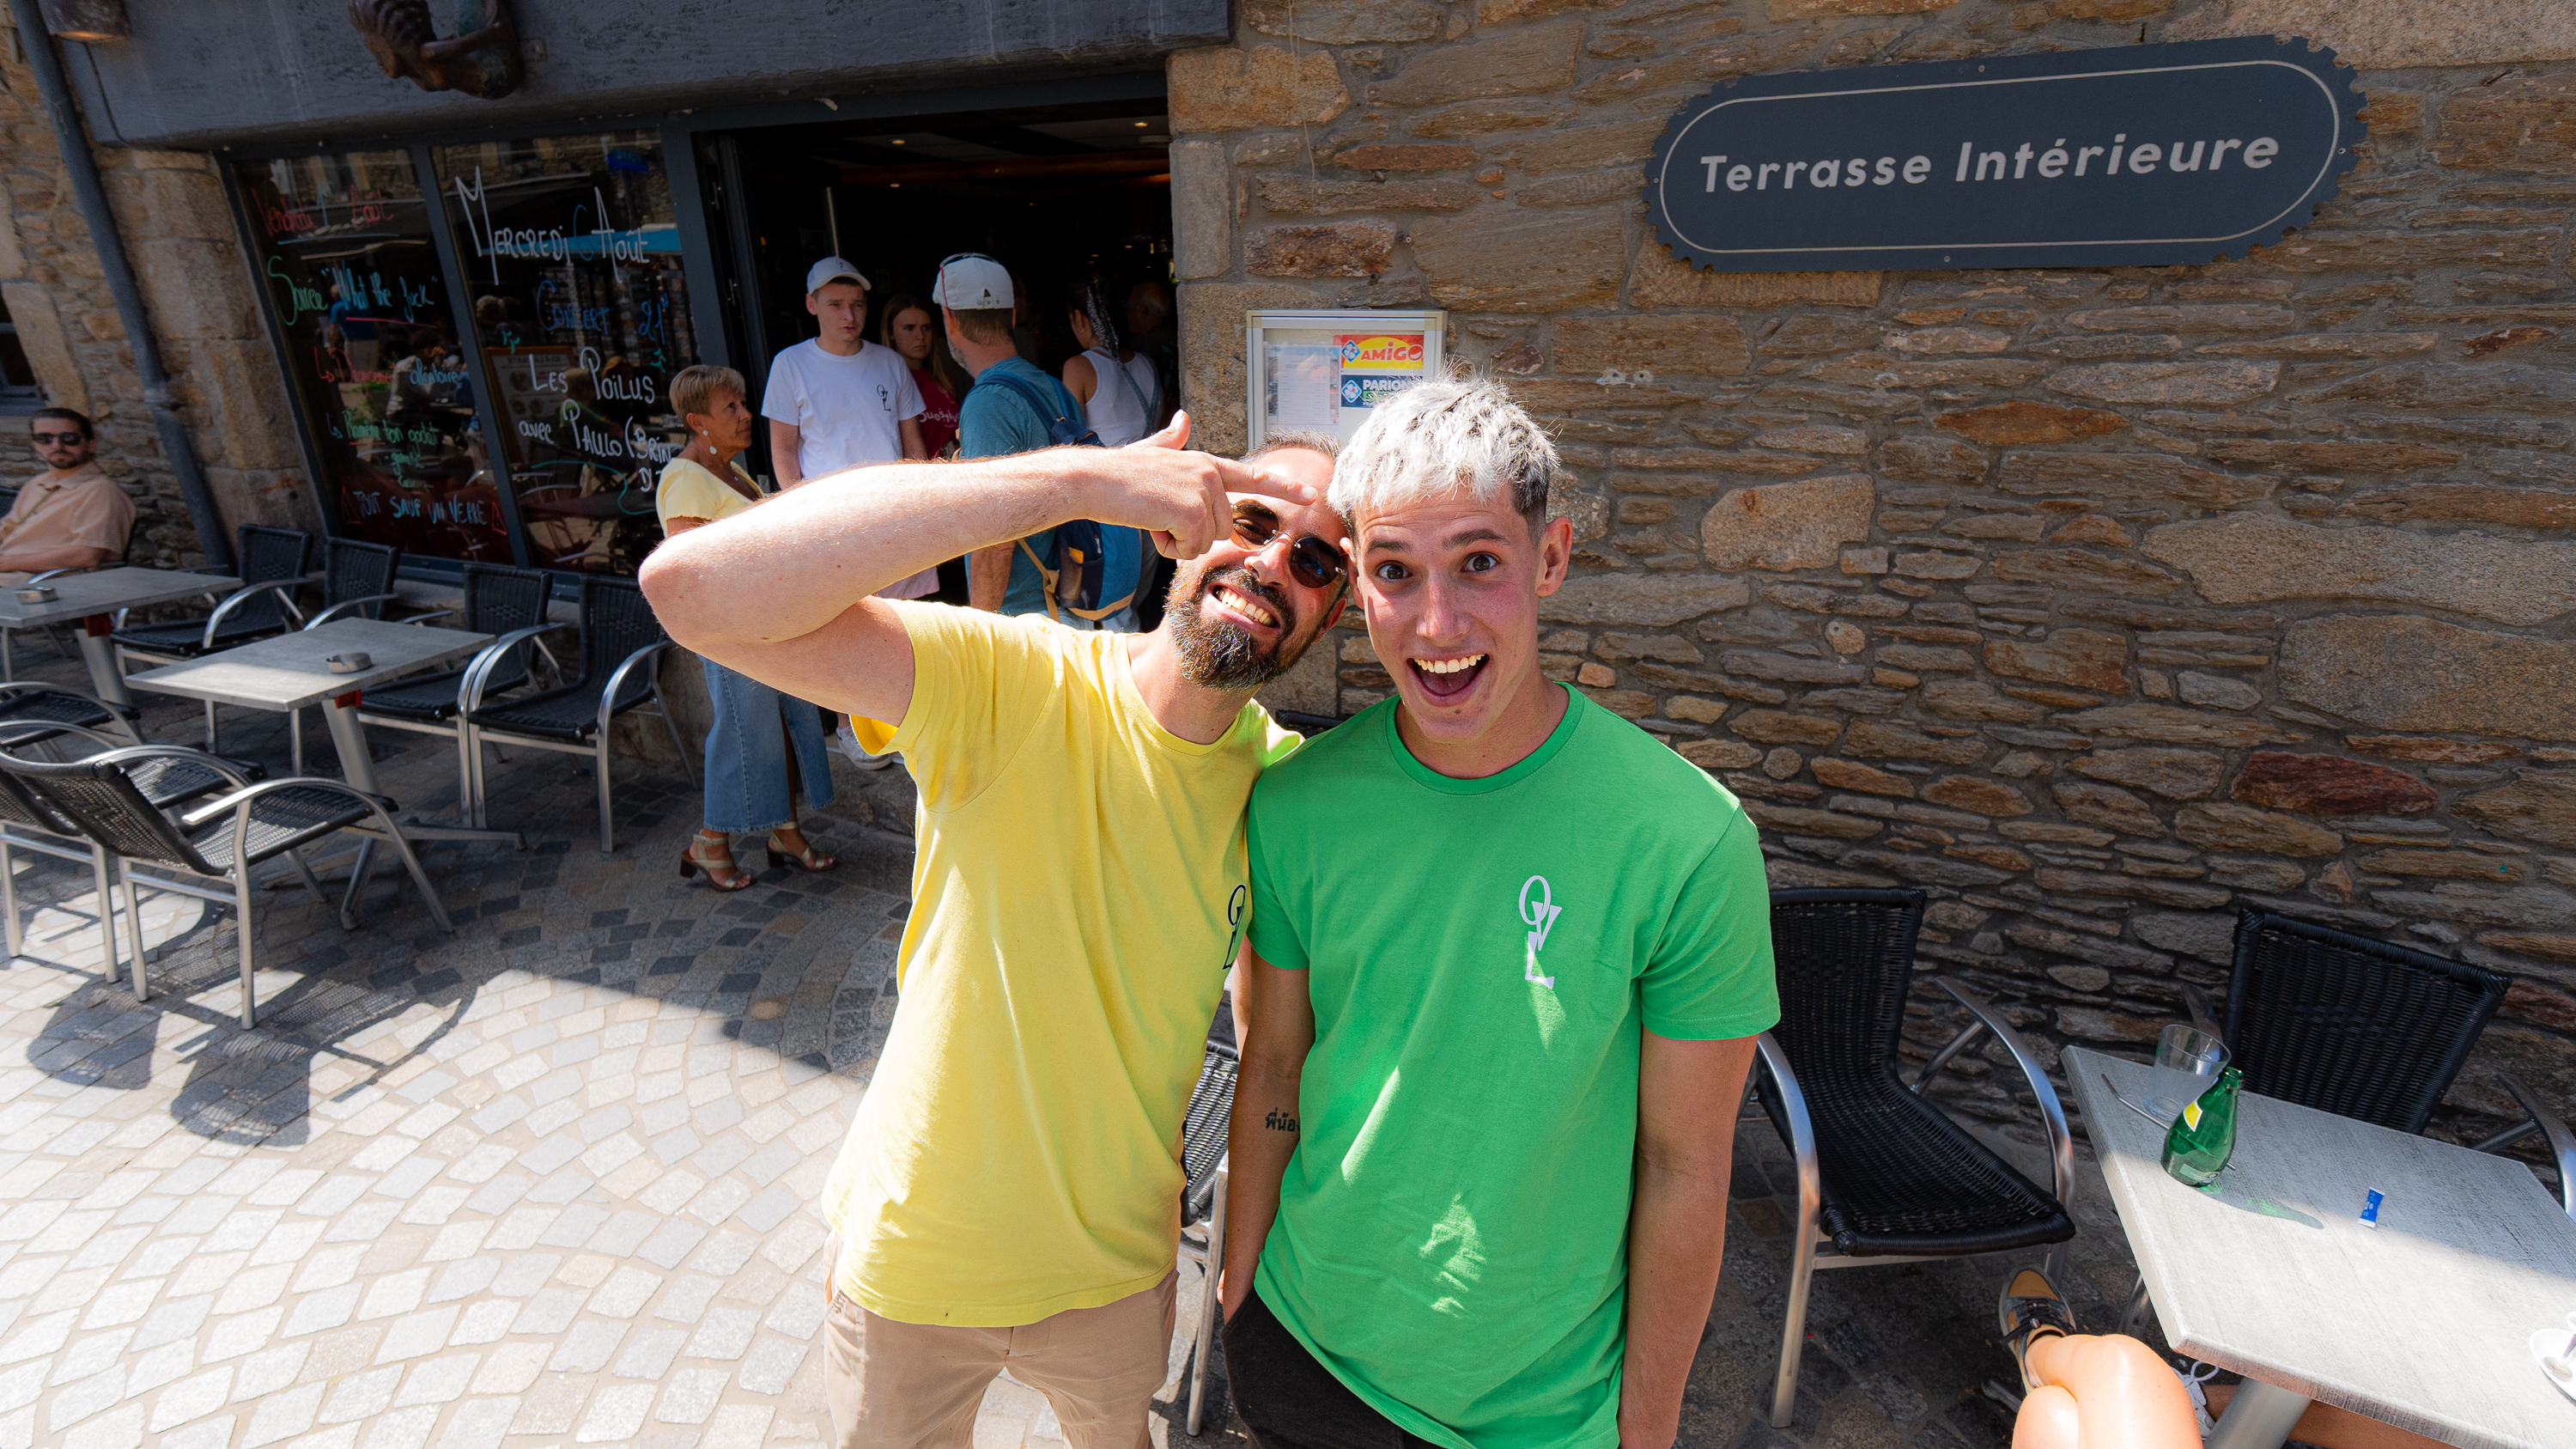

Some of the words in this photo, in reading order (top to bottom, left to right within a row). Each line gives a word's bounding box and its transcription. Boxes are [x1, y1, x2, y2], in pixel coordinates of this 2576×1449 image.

[1700, 155, 1932, 193] Terrasse
[1955, 133, 2279, 182] Intérieure
[1362, 379, 1414, 391] PARION
[518, 419, 555, 445] avec
